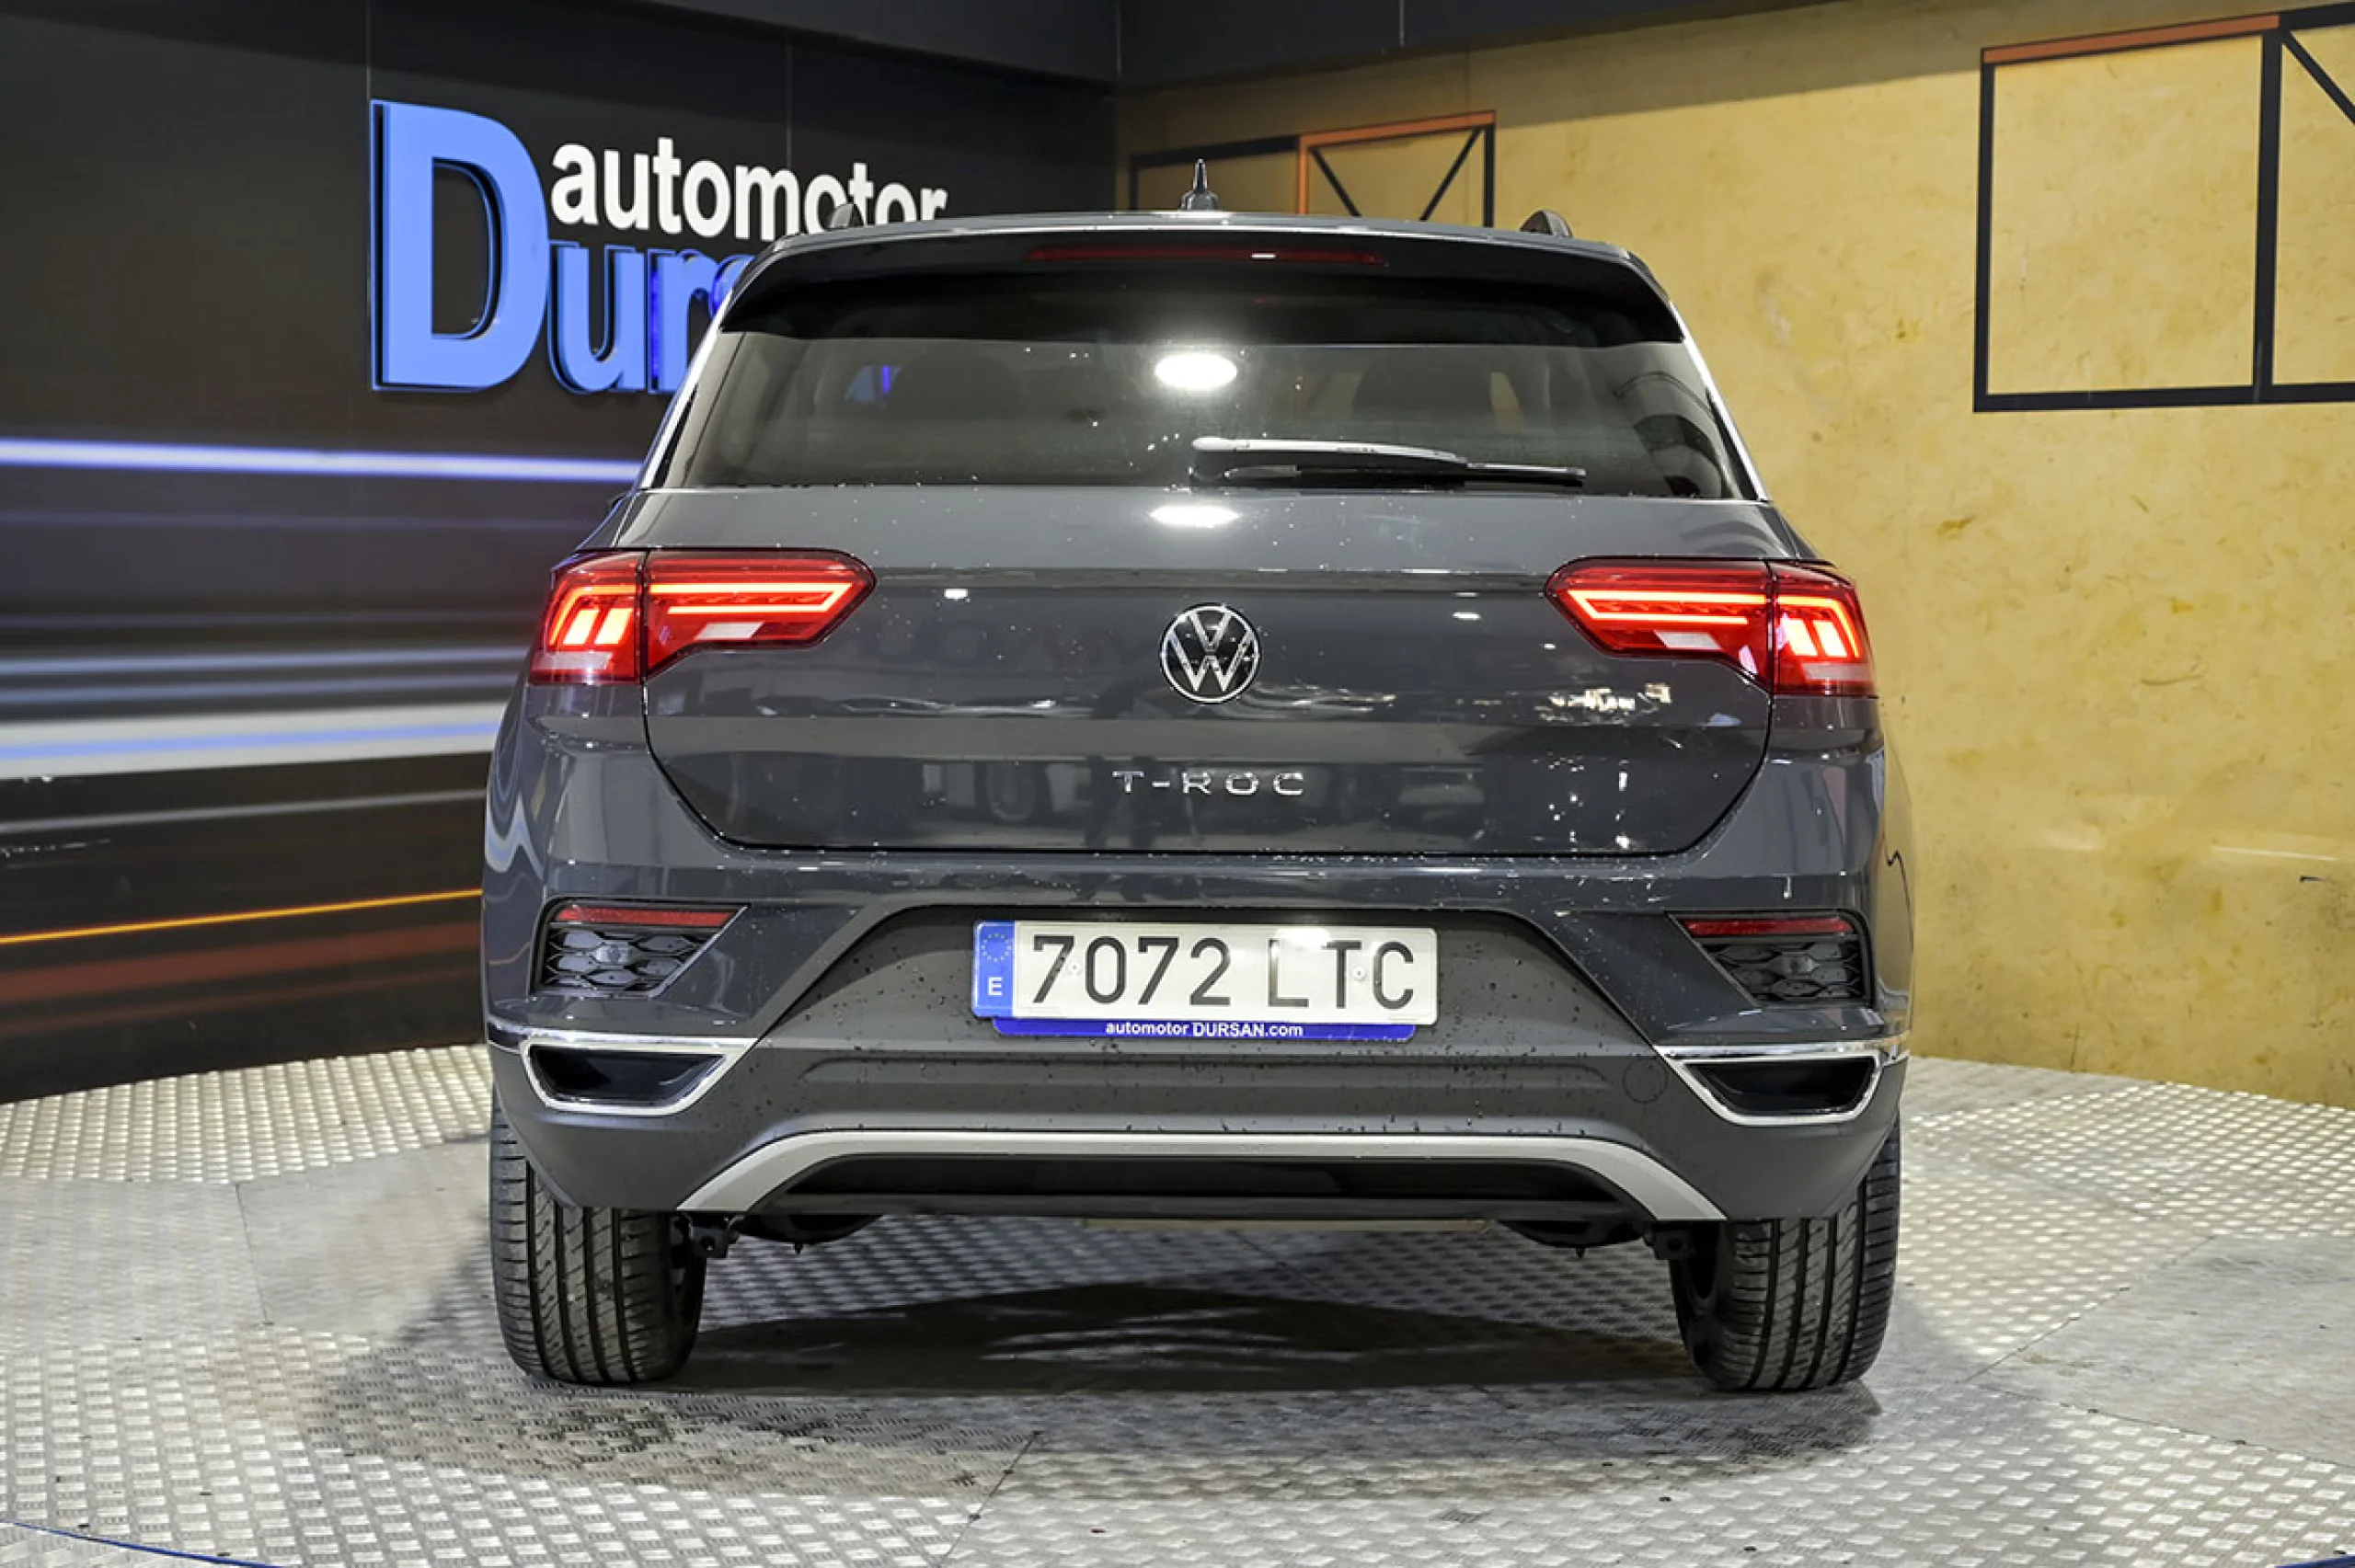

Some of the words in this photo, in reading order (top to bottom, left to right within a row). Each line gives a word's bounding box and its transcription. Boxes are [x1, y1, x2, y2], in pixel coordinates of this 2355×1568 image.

[552, 137, 948, 241] automotor
[1112, 770, 1304, 795] T-ROC
[1032, 934, 1232, 1006] 7072
[1268, 936, 1415, 1010] LTC
[987, 977, 1004, 996] E
[1105, 1021, 1189, 1036] automotor
[1192, 1022, 1304, 1037] DURSAN.com
